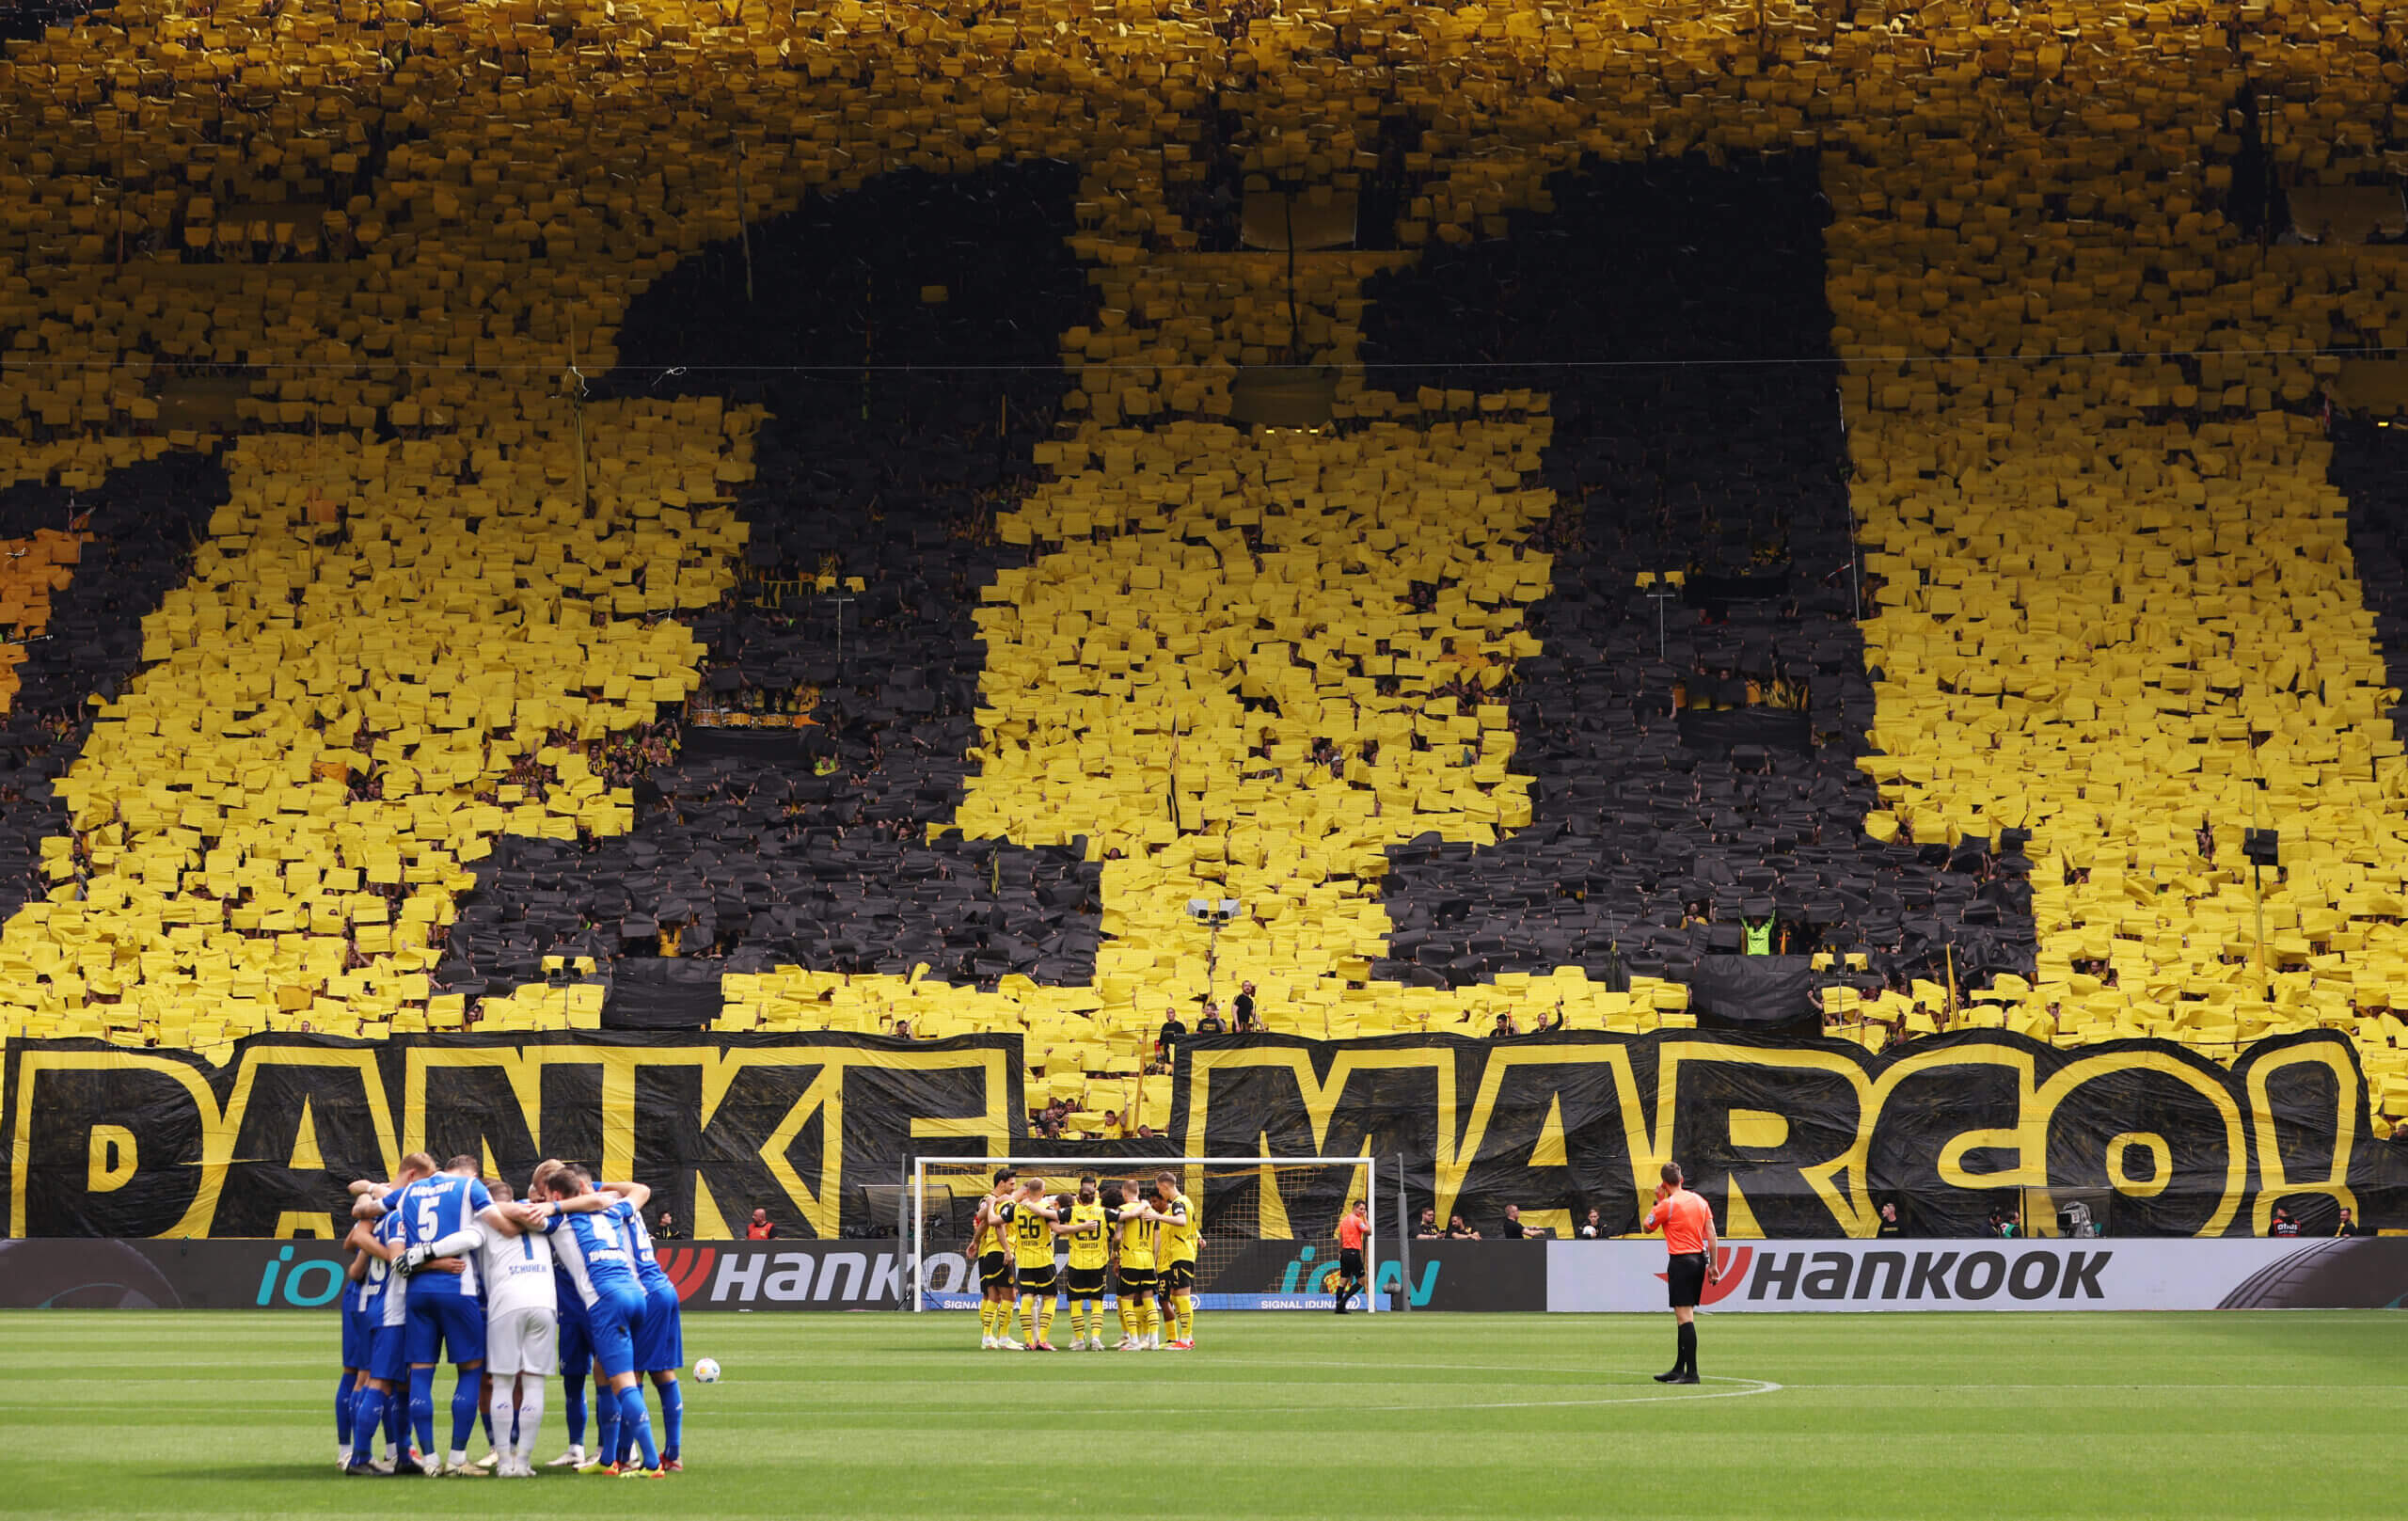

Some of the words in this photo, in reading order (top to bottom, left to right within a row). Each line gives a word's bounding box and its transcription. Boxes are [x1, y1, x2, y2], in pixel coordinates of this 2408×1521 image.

[10, 1042, 1012, 1240] DANKE
[418, 1196, 440, 1242] 5
[590, 1213, 619, 1248] 4
[1018, 1215, 1040, 1239] 26
[522, 1233, 534, 1260] 1
[943, 1300, 980, 1309] SIGNA
[1260, 1300, 1302, 1309] SIGNAL
